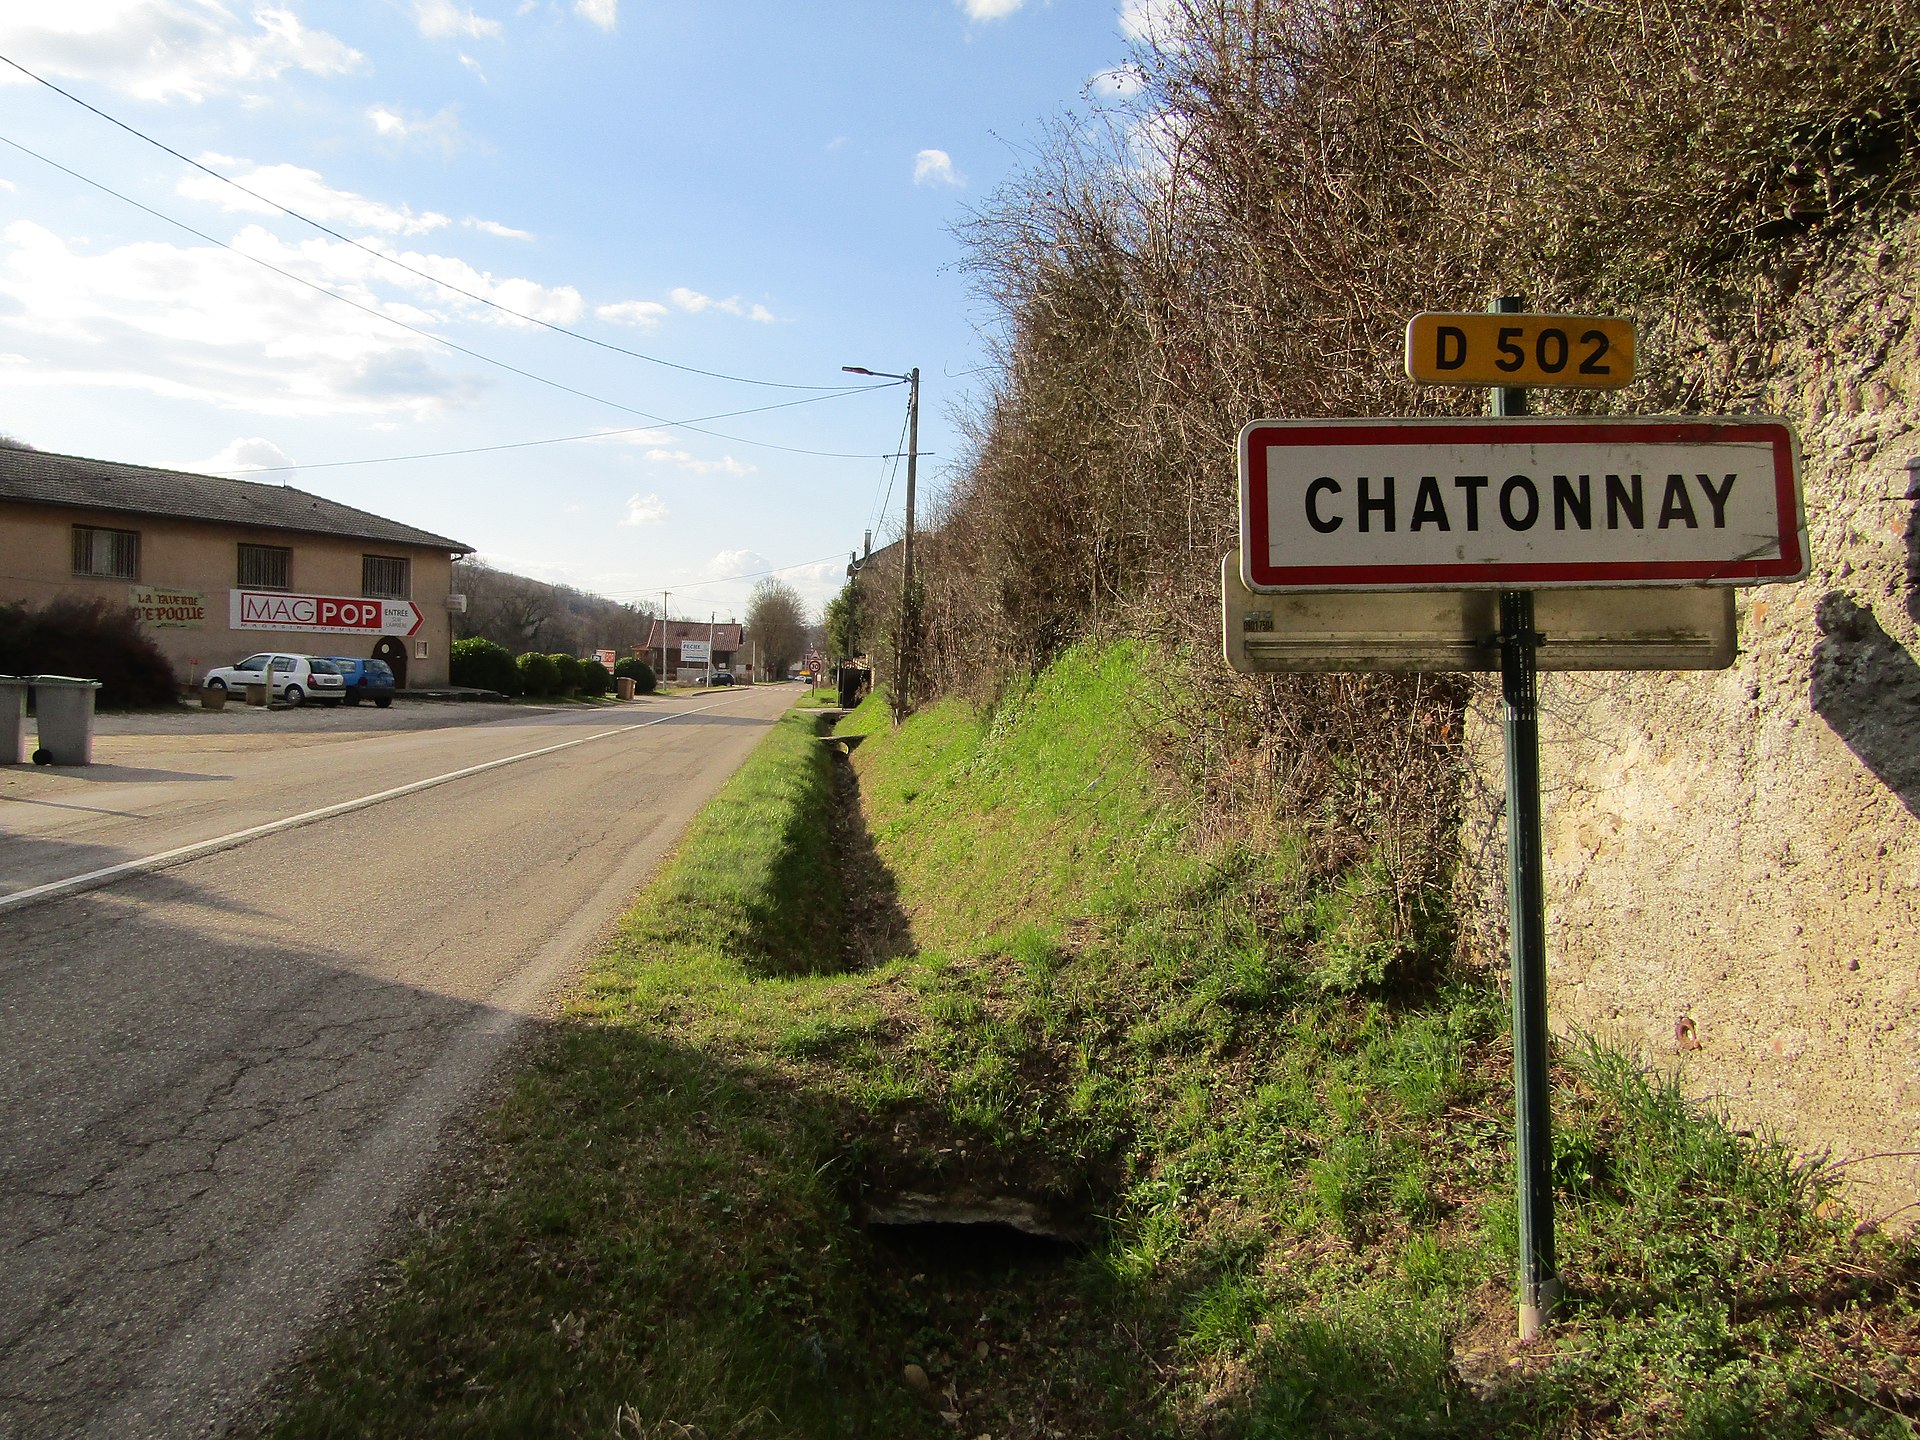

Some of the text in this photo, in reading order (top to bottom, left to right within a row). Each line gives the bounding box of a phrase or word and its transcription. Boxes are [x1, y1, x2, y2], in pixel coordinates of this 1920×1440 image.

[1436, 326, 1610, 375] D 502
[1304, 473, 1738, 534] CHATONNAY
[137, 594, 153, 603] LA
[246, 598, 377, 626] MAG POP
